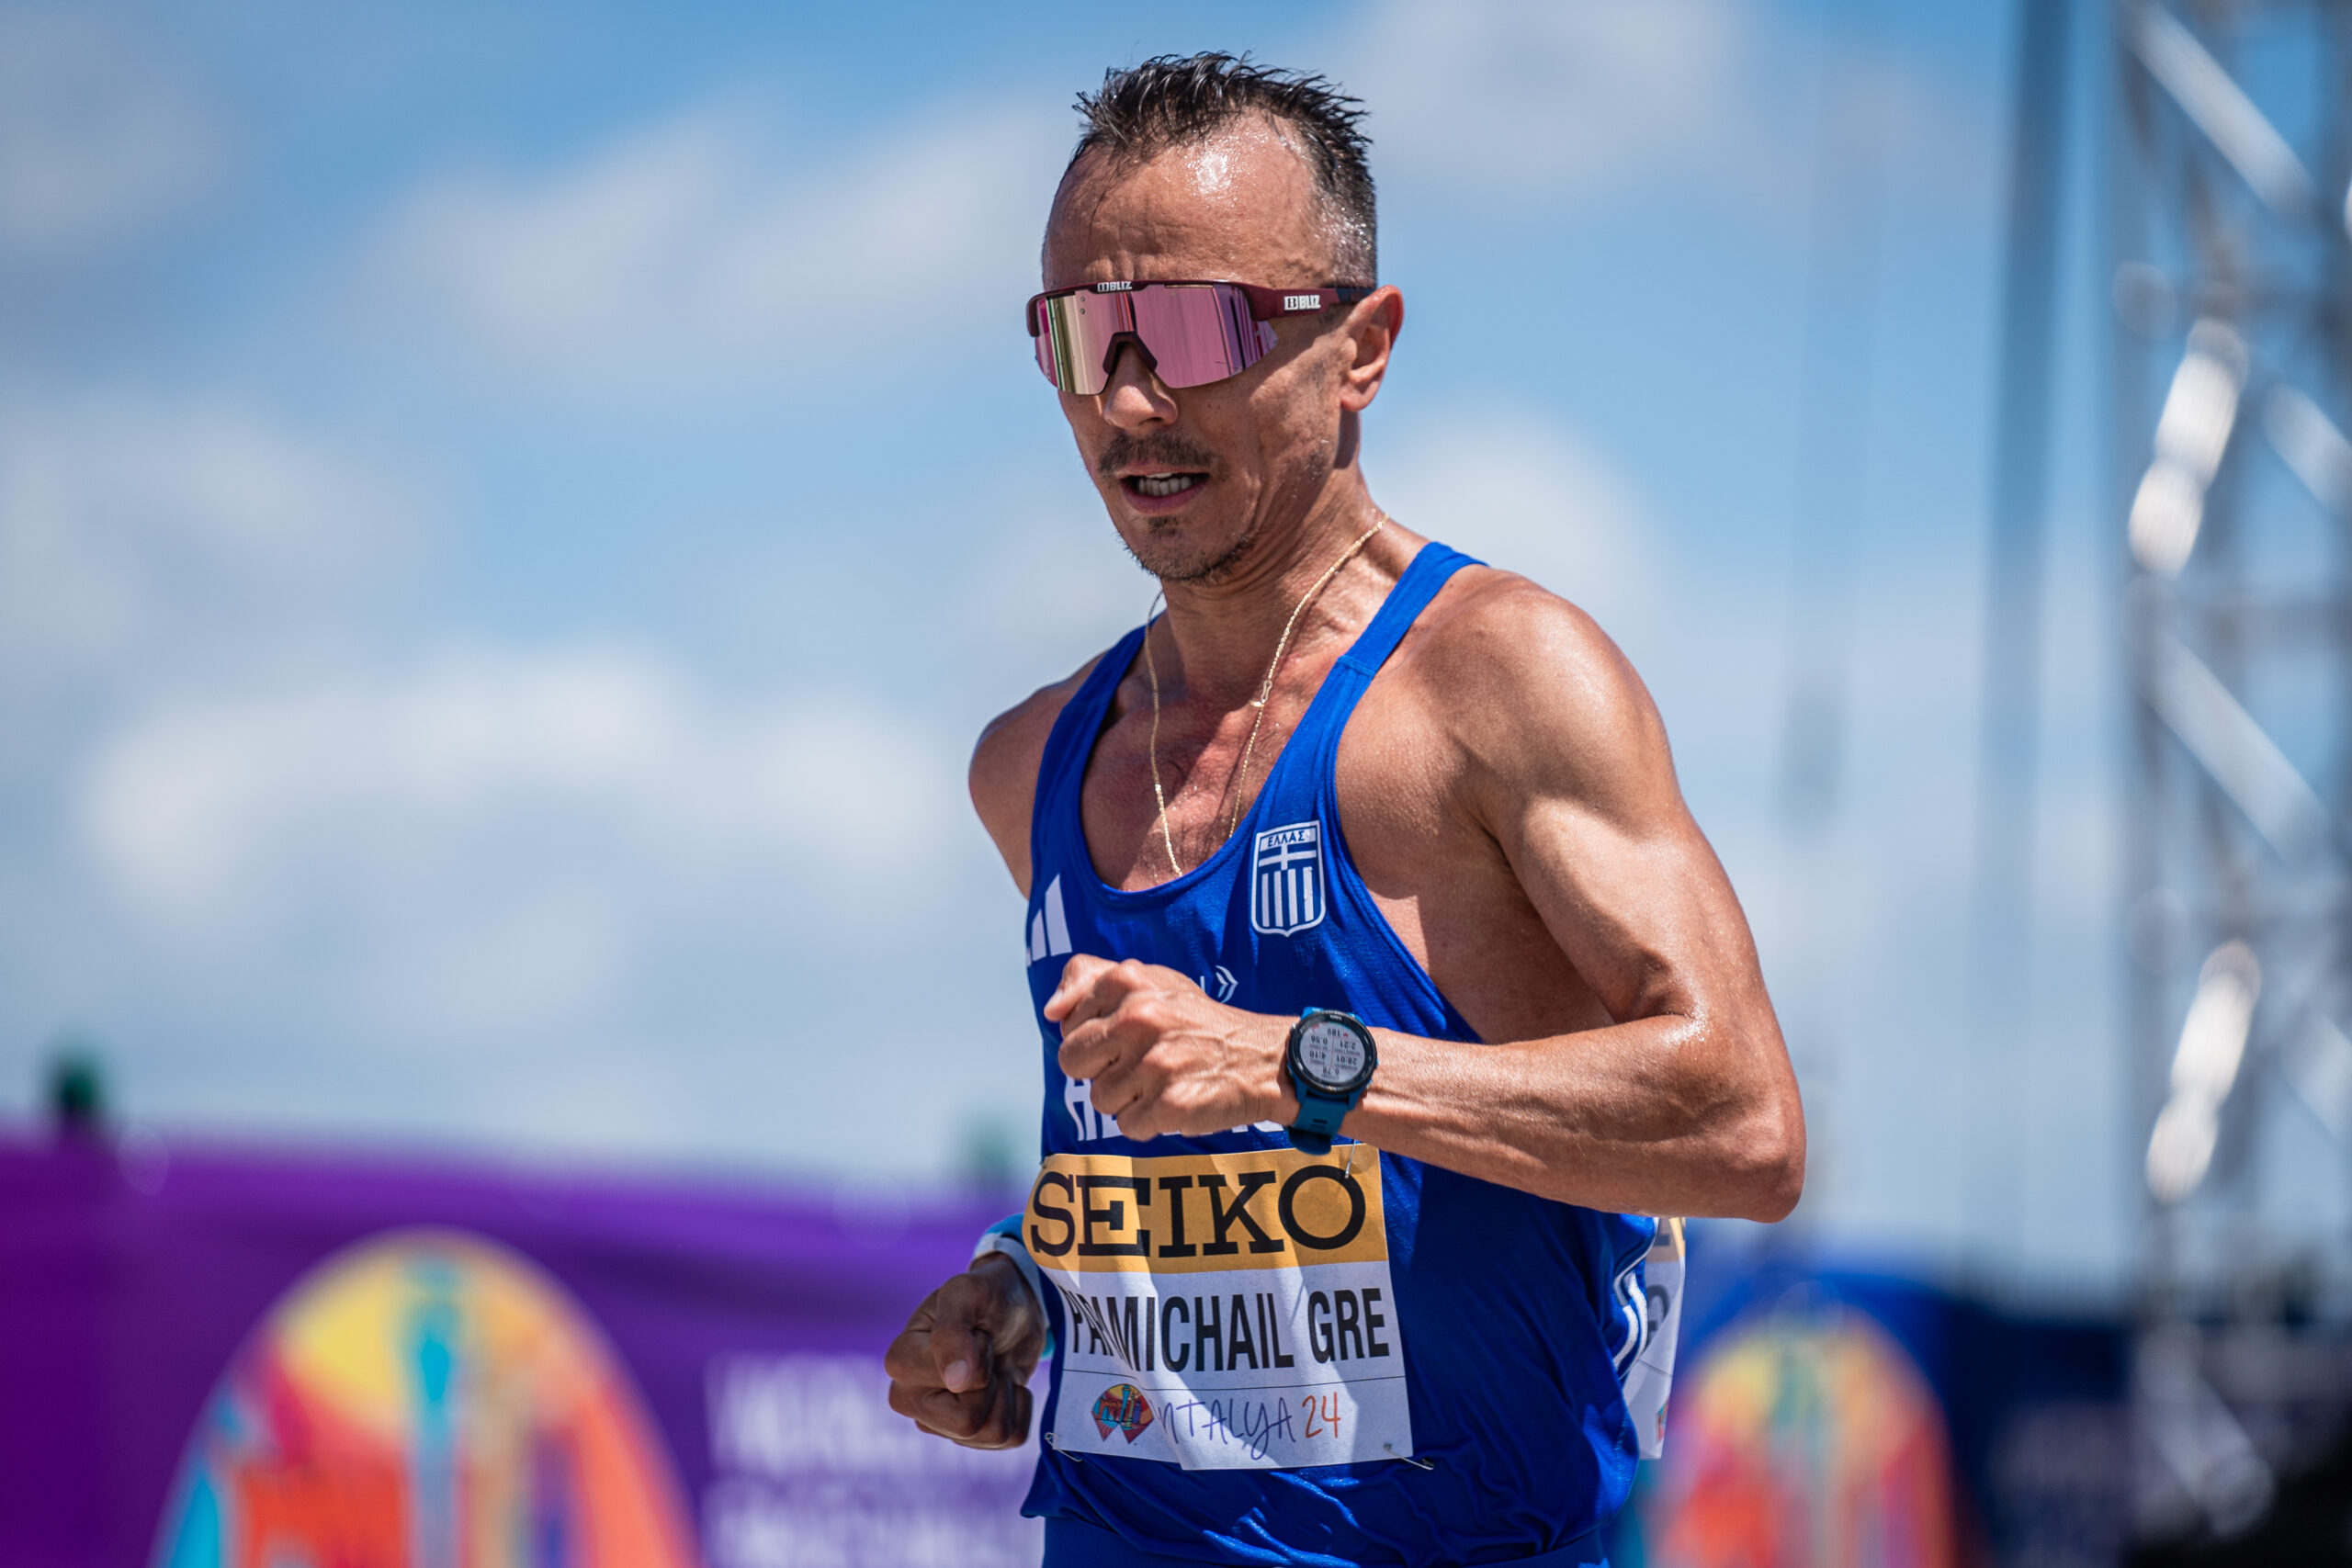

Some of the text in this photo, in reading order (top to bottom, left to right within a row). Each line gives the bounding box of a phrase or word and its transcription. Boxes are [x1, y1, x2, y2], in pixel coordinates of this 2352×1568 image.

[1109, 280, 1133, 292] BLIZ
[1298, 294, 1321, 310] BLIZ
[1268, 830, 1306, 847] ΕΛΛΑΣ
[1030, 1164, 1366, 1258] SEIKO
[1307, 1288, 1390, 1364] GRE
[1301, 1391, 1341, 1439] 24
